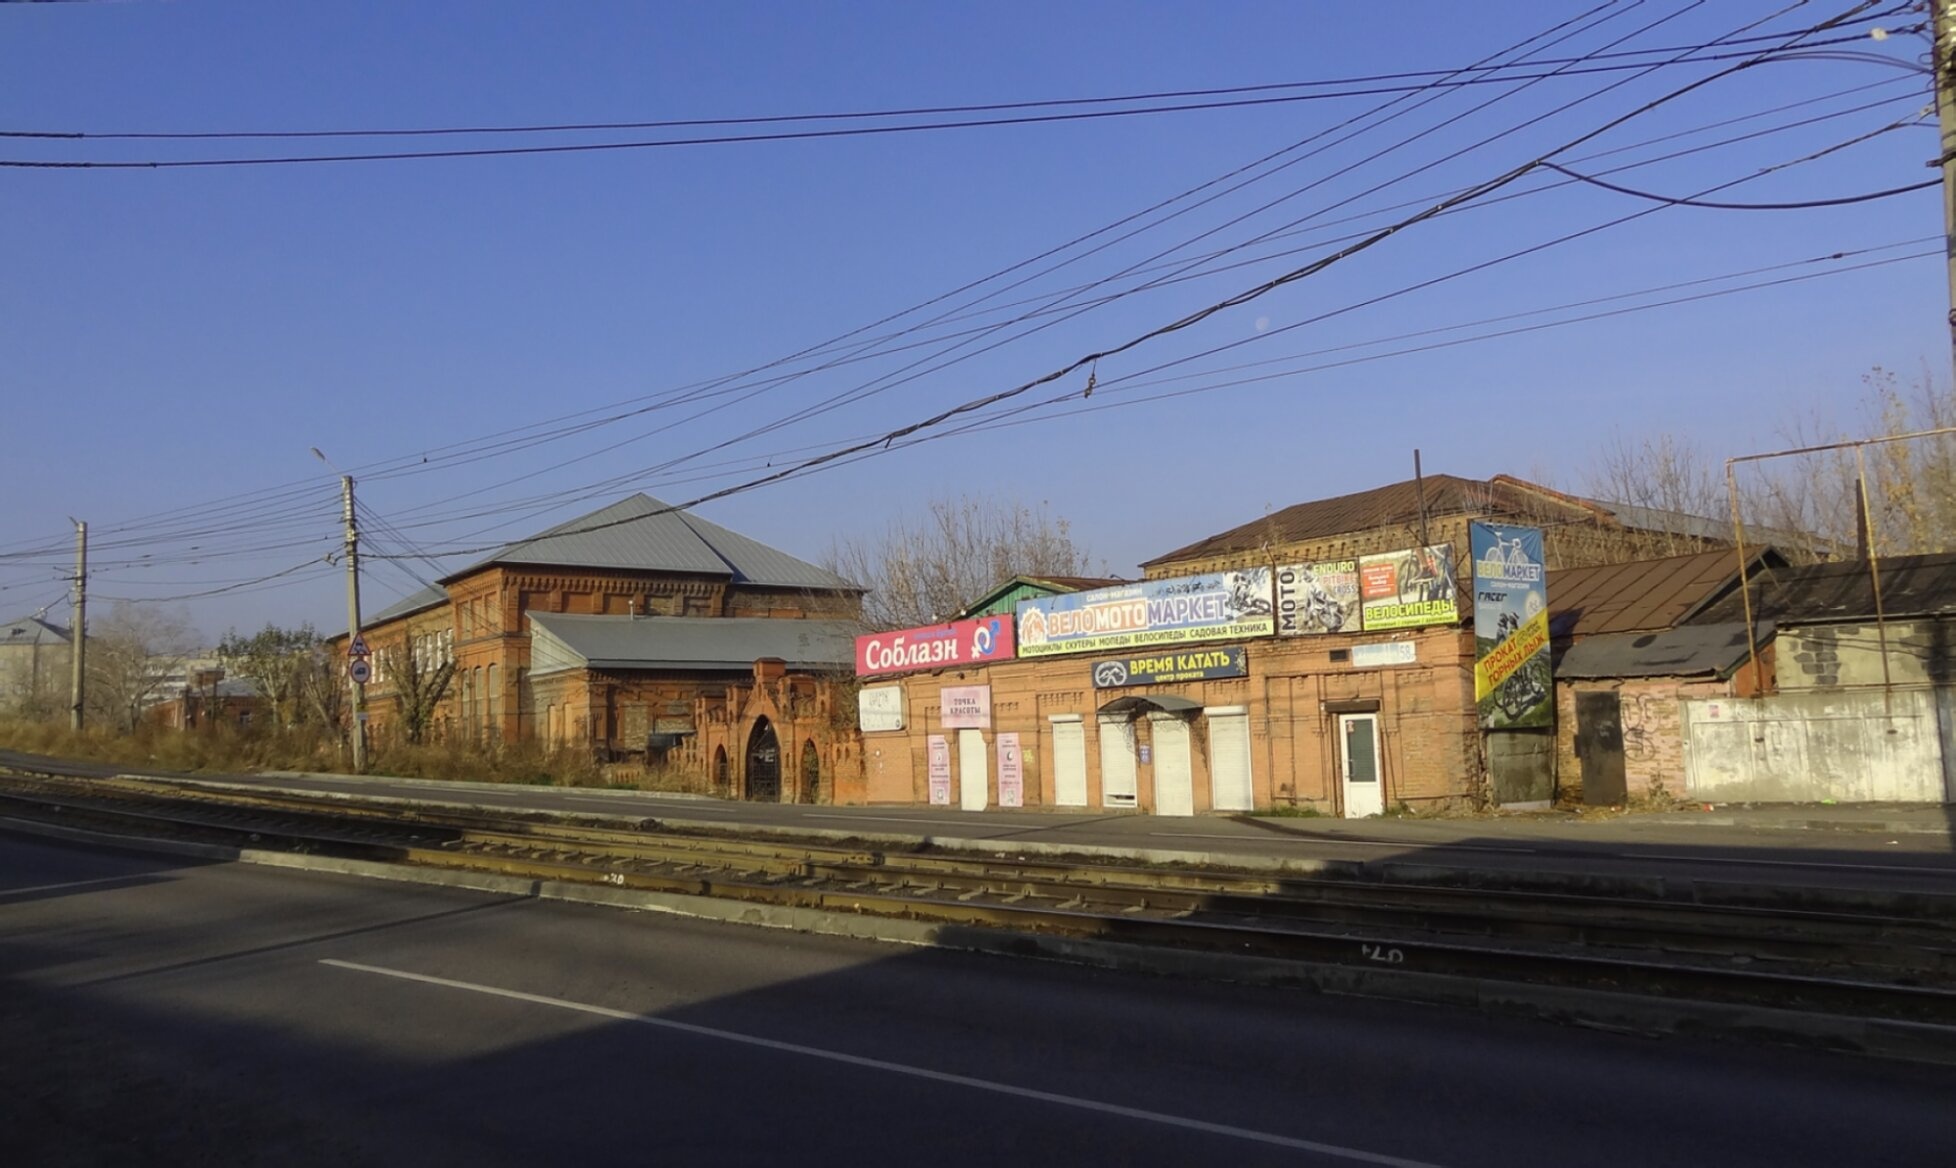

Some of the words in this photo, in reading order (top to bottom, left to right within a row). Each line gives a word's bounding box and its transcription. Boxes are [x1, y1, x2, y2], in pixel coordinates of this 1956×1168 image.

[1313, 561, 1355, 575] ENDURO
[1365, 599, 1455, 619] ВЕЛОСИПЕДЫ
[1022, 644, 1062, 655] МОТОЦИКЛЫ
[1065, 639, 1096, 650] СКУТЕРЫ
[1099, 635, 1132, 646] МОПЕДЫ
[1134, 630, 1187, 644] ВЕЛОСИПЕДЫ
[1189, 626, 1228, 638] САДОВАЯ
[1230, 623, 1268, 634] ТЕХНИКА
[865, 635, 959, 670] Соблазн
[1130, 656, 1174, 675] ВРЕМЯ
[1177, 651, 1230, 671] КАТАТЬ
[1483, 637, 1517, 673] ПРОКАТ
[1488, 652, 1523, 687] ГОРНЫХ
[1523, 632, 1545, 658] ЛЫЖ
[950, 706, 981, 715] КРАСОТЫ
[953, 697, 976, 706] ТОЧКА
